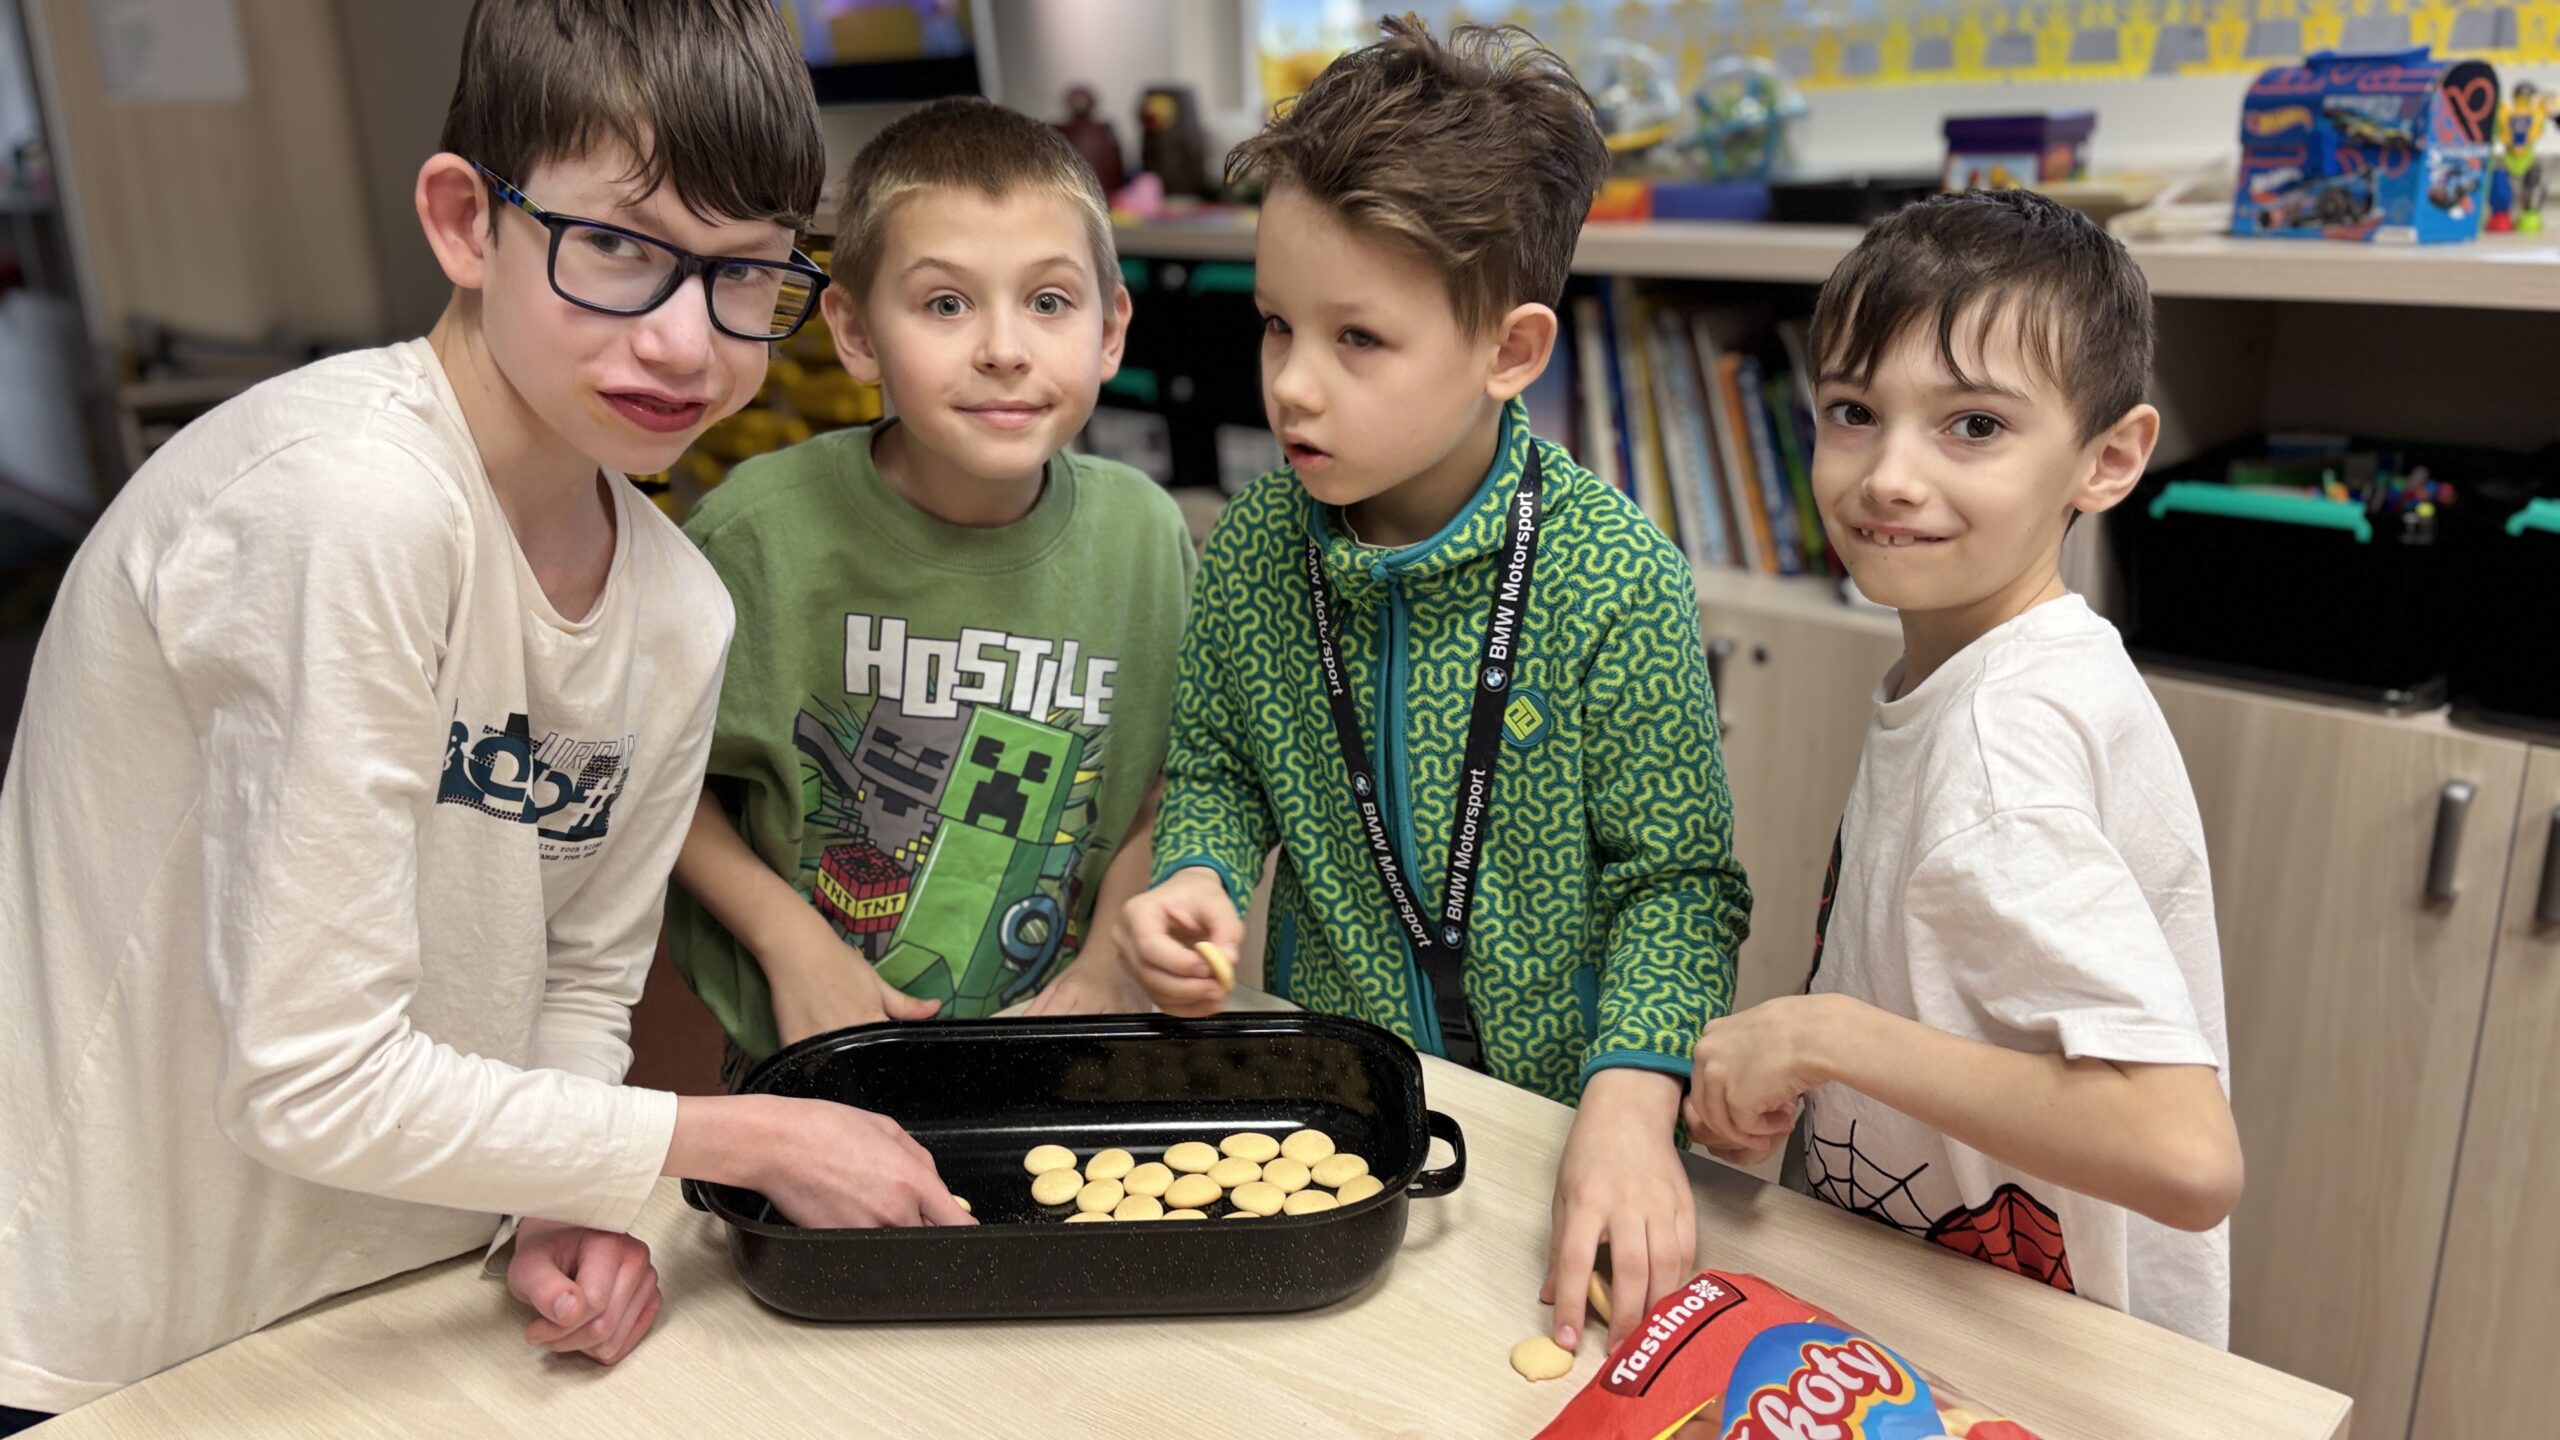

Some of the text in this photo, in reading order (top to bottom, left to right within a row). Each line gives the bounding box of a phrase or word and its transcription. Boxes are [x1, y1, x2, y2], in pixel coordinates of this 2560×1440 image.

[1308, 540, 1321, 585] MW
[1489, 491, 1535, 660] BMW Motorsport
[844, 612, 1119, 726] HOSTILE
[823, 873, 852, 912] TNT
[1362, 802, 1432, 948] BMW Motorsport
[1446, 768, 1486, 921] BMW Motorsport
[863, 897, 901, 916] TNT
[1611, 1295, 1705, 1385] Tastino
[1736, 1344, 1892, 1440] koty
